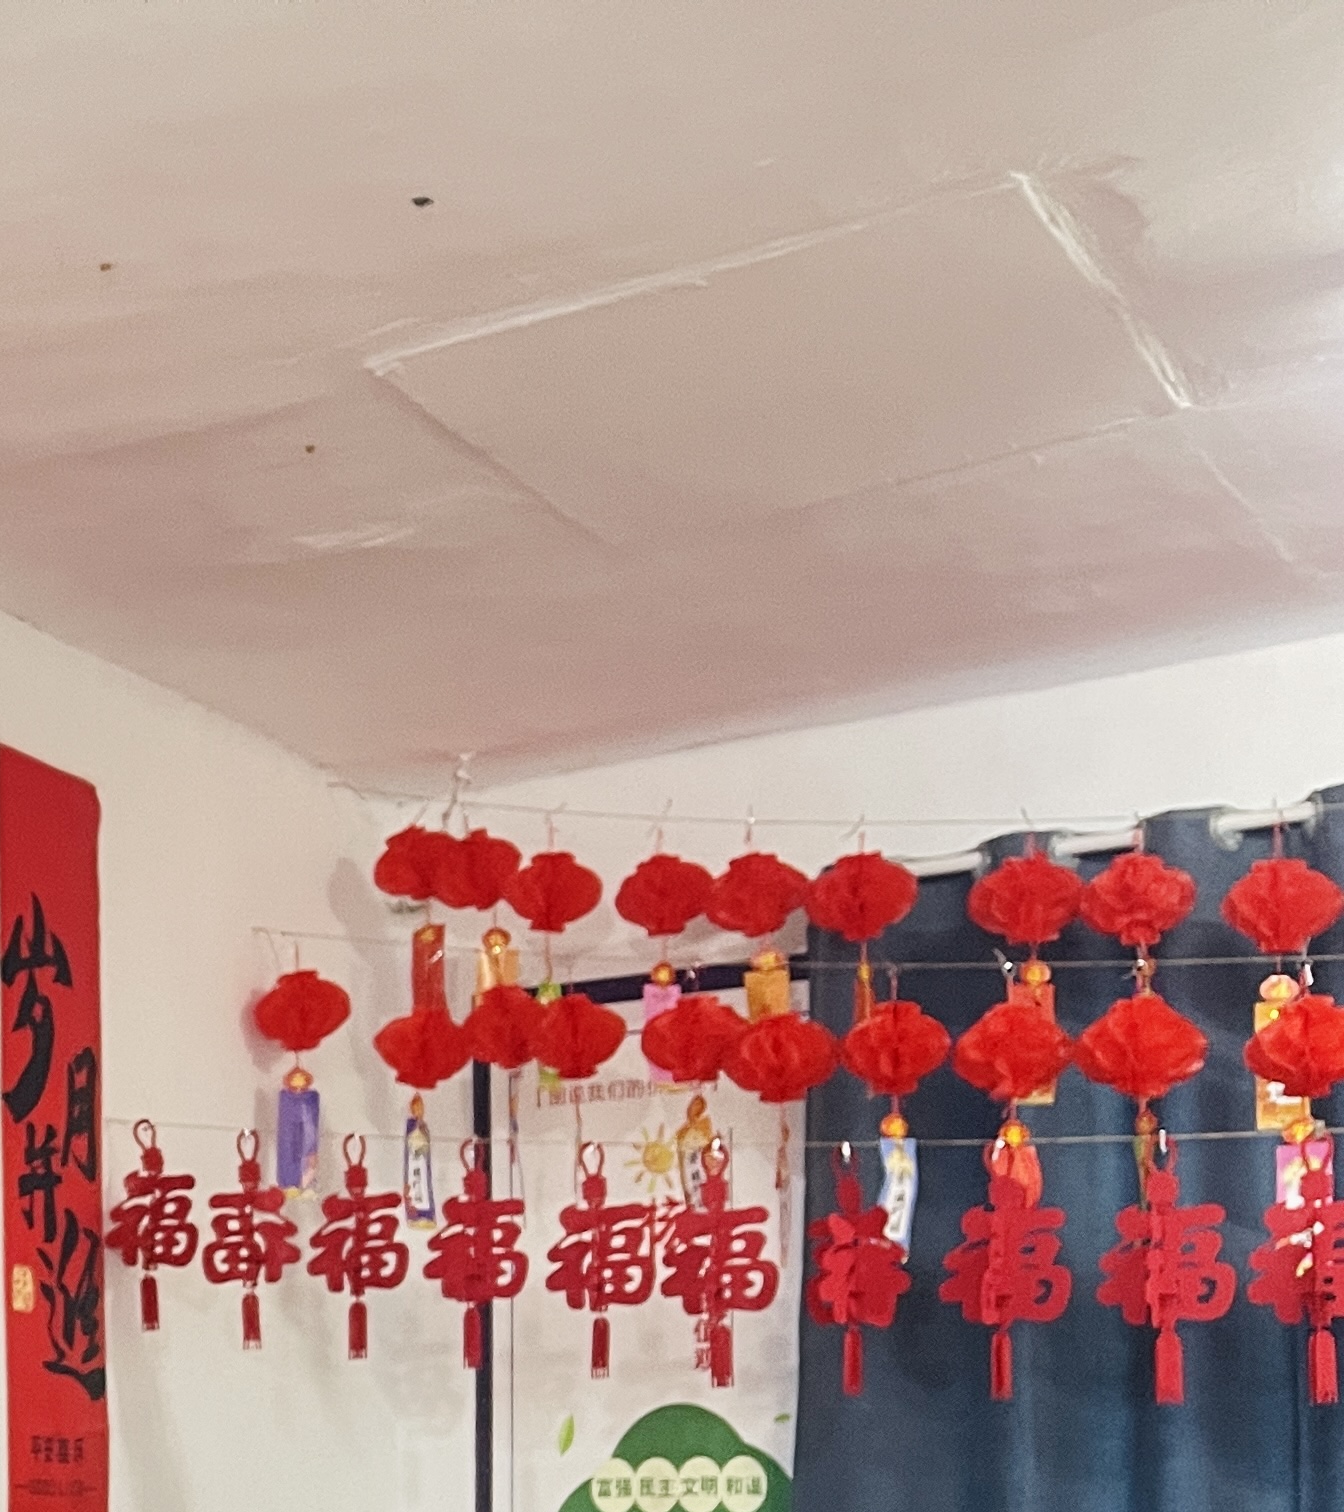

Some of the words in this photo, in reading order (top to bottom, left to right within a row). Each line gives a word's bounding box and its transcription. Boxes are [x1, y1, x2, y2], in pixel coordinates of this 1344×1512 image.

[109, 1171, 199, 1268] 福
[309, 1192, 410, 1293] 福
[545, 1203, 655, 1312] 福
[661, 1205, 780, 1315] 福
